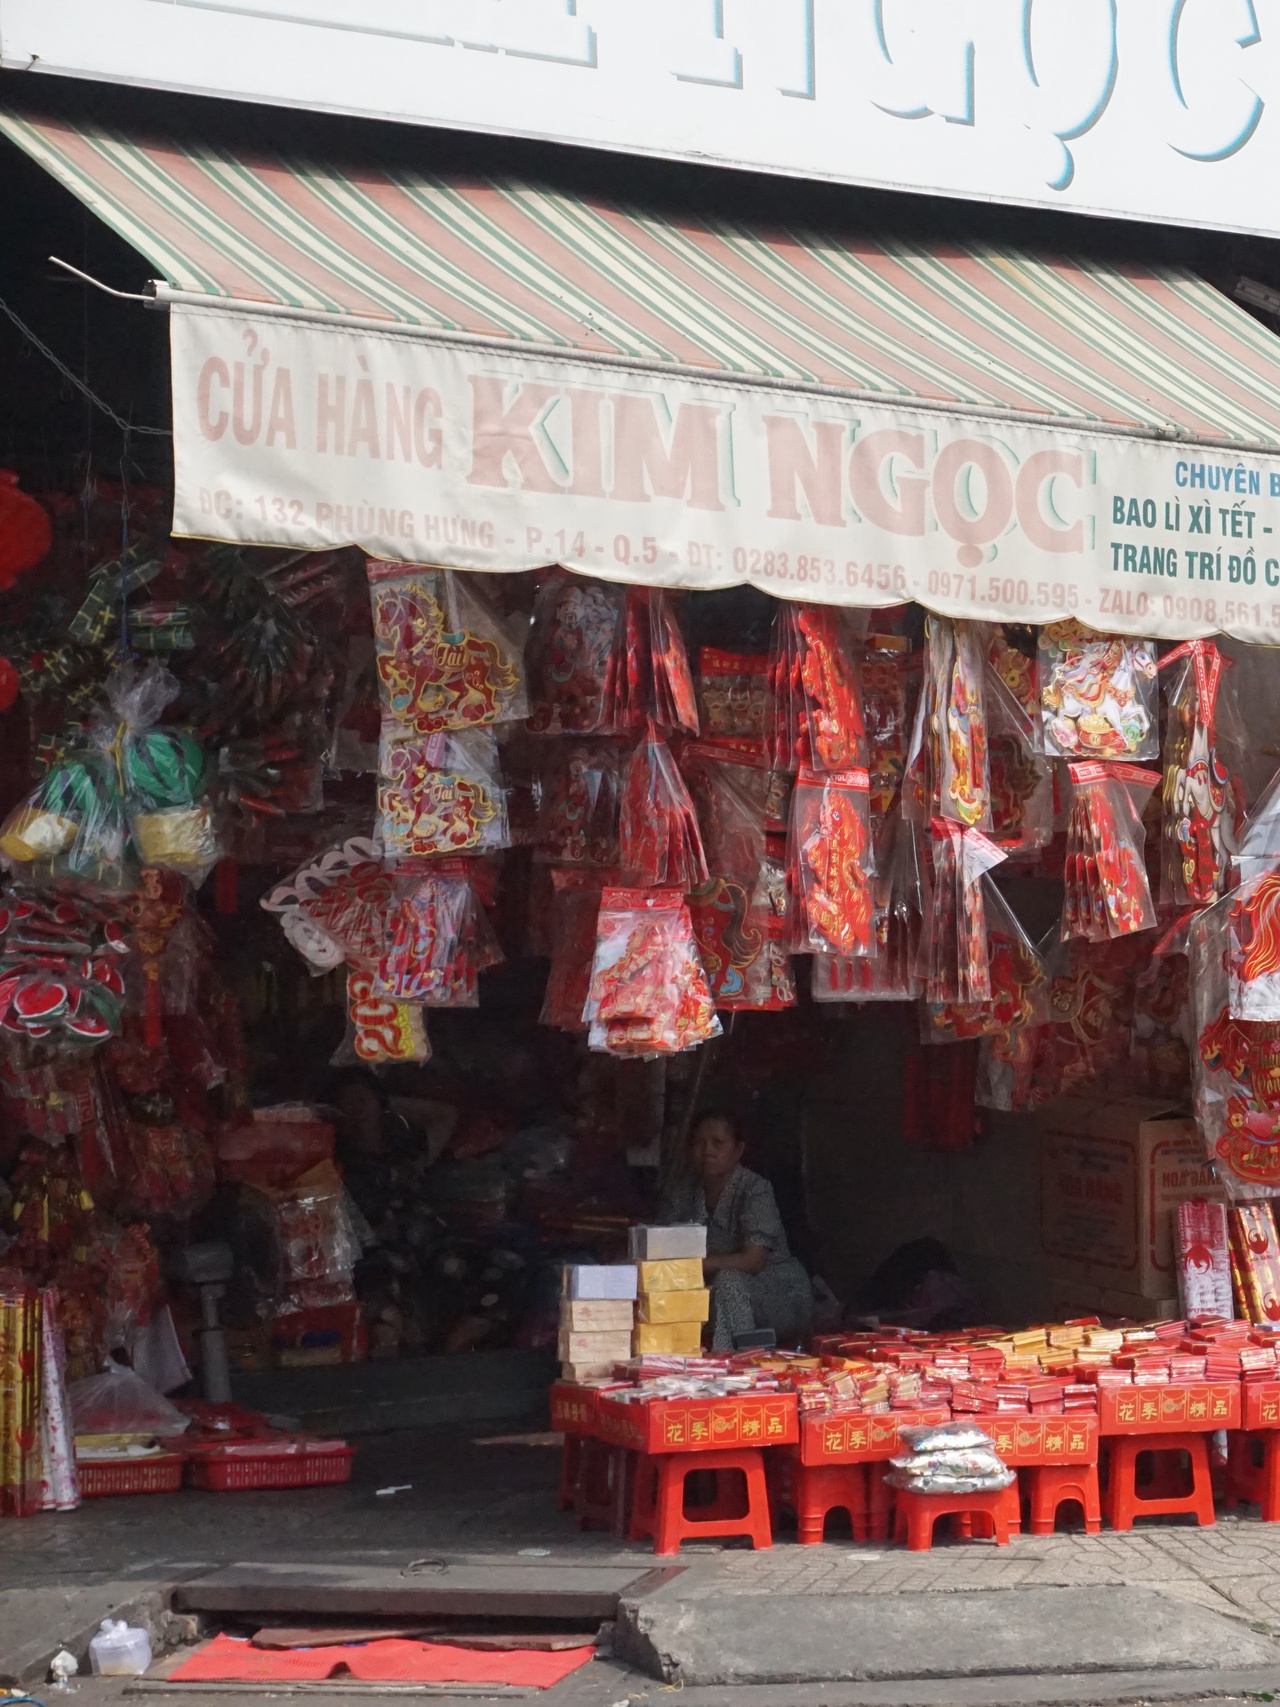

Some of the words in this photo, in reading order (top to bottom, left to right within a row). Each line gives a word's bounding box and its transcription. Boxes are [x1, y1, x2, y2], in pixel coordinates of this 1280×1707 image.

[197, 328, 297, 450] CỬA
[316, 354, 443, 470] HÀNG
[467, 370, 737, 511] KIM
[762, 410, 1094, 568] NGỌC
[1175, 461, 1260, 495] CHUYÊN
[1112, 495, 1157, 529] BAO
[1165, 495, 1181, 532] LÌ
[1188, 498, 1212, 535] XÌ
[1219, 499, 1256, 539] TẾT
[254, 495, 305, 527] 132
[315, 500, 415, 540] PHÙNG
[424, 512, 495, 549] HƯNG
[526, 527, 586, 558] P.14
[613, 534, 657, 564] Q.5
[732, 546, 906, 592] 0283.853.6456
[927, 570, 1079, 609] 0971.500.595
[1099, 588, 1157, 617] ZALO:
[1110, 542, 1178, 579] TRANG
[1185, 546, 1222, 581] TRÍ
[1228, 546, 1256, 586] ĐỒ
